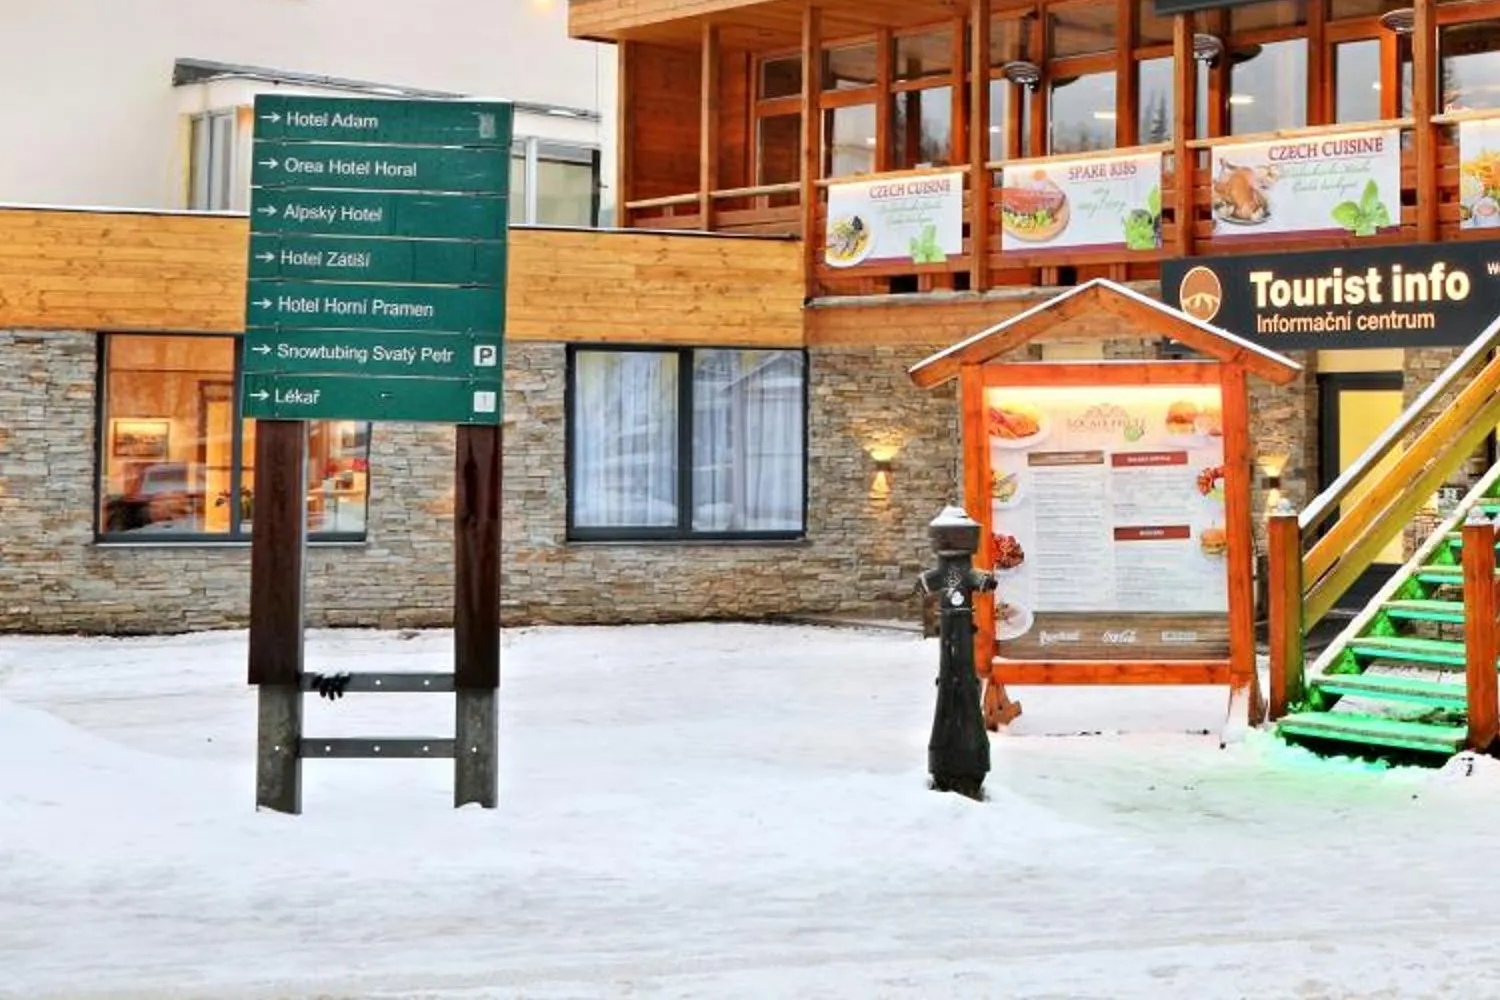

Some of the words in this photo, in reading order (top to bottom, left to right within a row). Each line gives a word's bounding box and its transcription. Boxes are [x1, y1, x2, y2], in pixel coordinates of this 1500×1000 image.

[286, 112, 328, 127] Hotel
[331, 113, 379, 129] Adam
[1268, 143, 1318, 161] CZECH
[1321, 137, 1383, 157] CUISINE
[285, 158, 324, 174] Orea
[329, 159, 370, 175] Hotel
[374, 161, 417, 177] Horal
[870, 184, 905, 198] CZECH
[907, 179, 951, 195] CUISINE
[283, 207, 336, 224] Alpský
[341, 207, 382, 222] Hotel
[281, 251, 321, 266] Hotel
[1250, 267, 1382, 308] Tourist
[1391, 261, 1470, 303] info
[278, 297, 319, 313] Hotel
[324, 297, 367, 315] Horní
[372, 300, 434, 318] Pramen
[1257, 310, 1351, 333] Informační
[1356, 309, 1435, 331] centrum
[277, 343, 368, 364] Snowtubing
[372, 346, 417, 364] Svatý
[421, 347, 454, 363] Petr
[479, 348, 492, 363] P
[275, 389, 321, 404] Lékař
